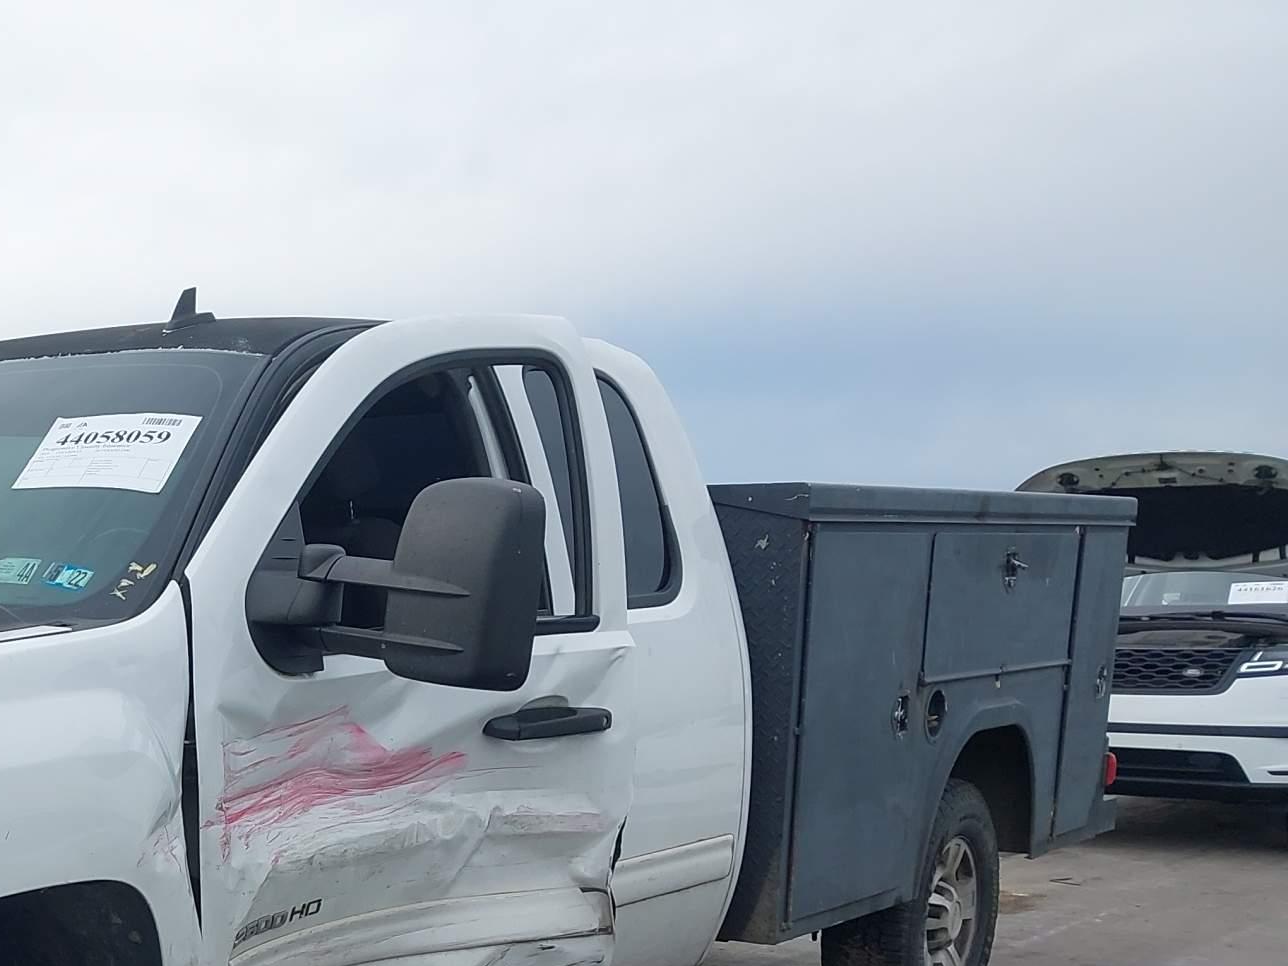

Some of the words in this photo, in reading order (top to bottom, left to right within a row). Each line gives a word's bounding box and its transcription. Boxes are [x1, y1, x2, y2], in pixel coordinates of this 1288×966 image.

[56, 430, 172, 446] 44058059
[16, 562, 37, 582] 4A
[67, 569, 89, 587] 22
[289, 898, 323, 922] HD
